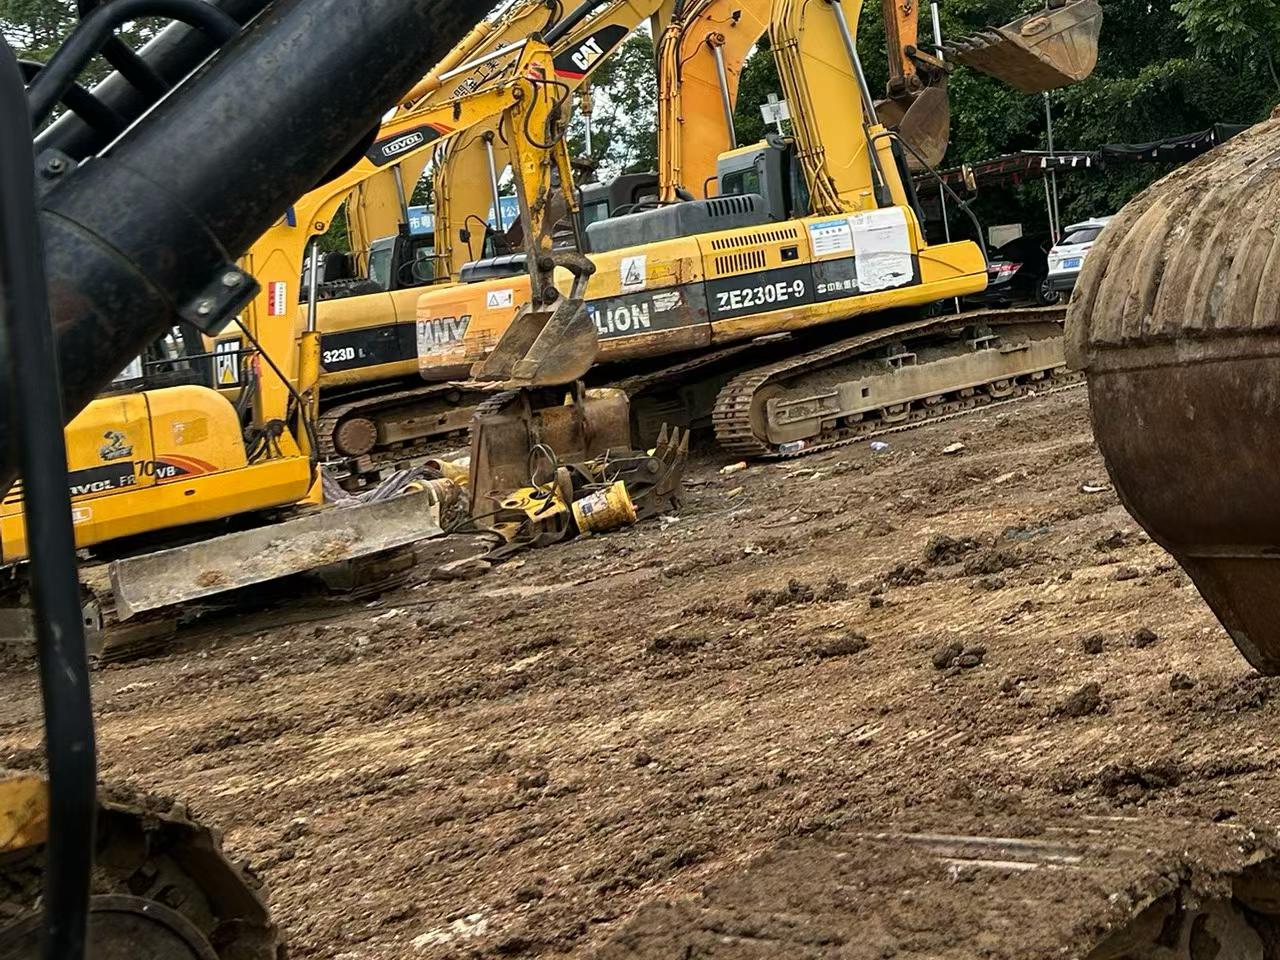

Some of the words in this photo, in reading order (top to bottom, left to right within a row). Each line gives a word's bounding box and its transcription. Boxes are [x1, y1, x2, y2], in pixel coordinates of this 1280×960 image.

[571, 36, 604, 71] CAT
[384, 134, 421, 154] LOVOL
[716, 279, 805, 312] ZE230E-9
[590, 302, 651, 335] LION
[216, 341, 240, 384] CAT
[323, 347, 355, 364] 323D
